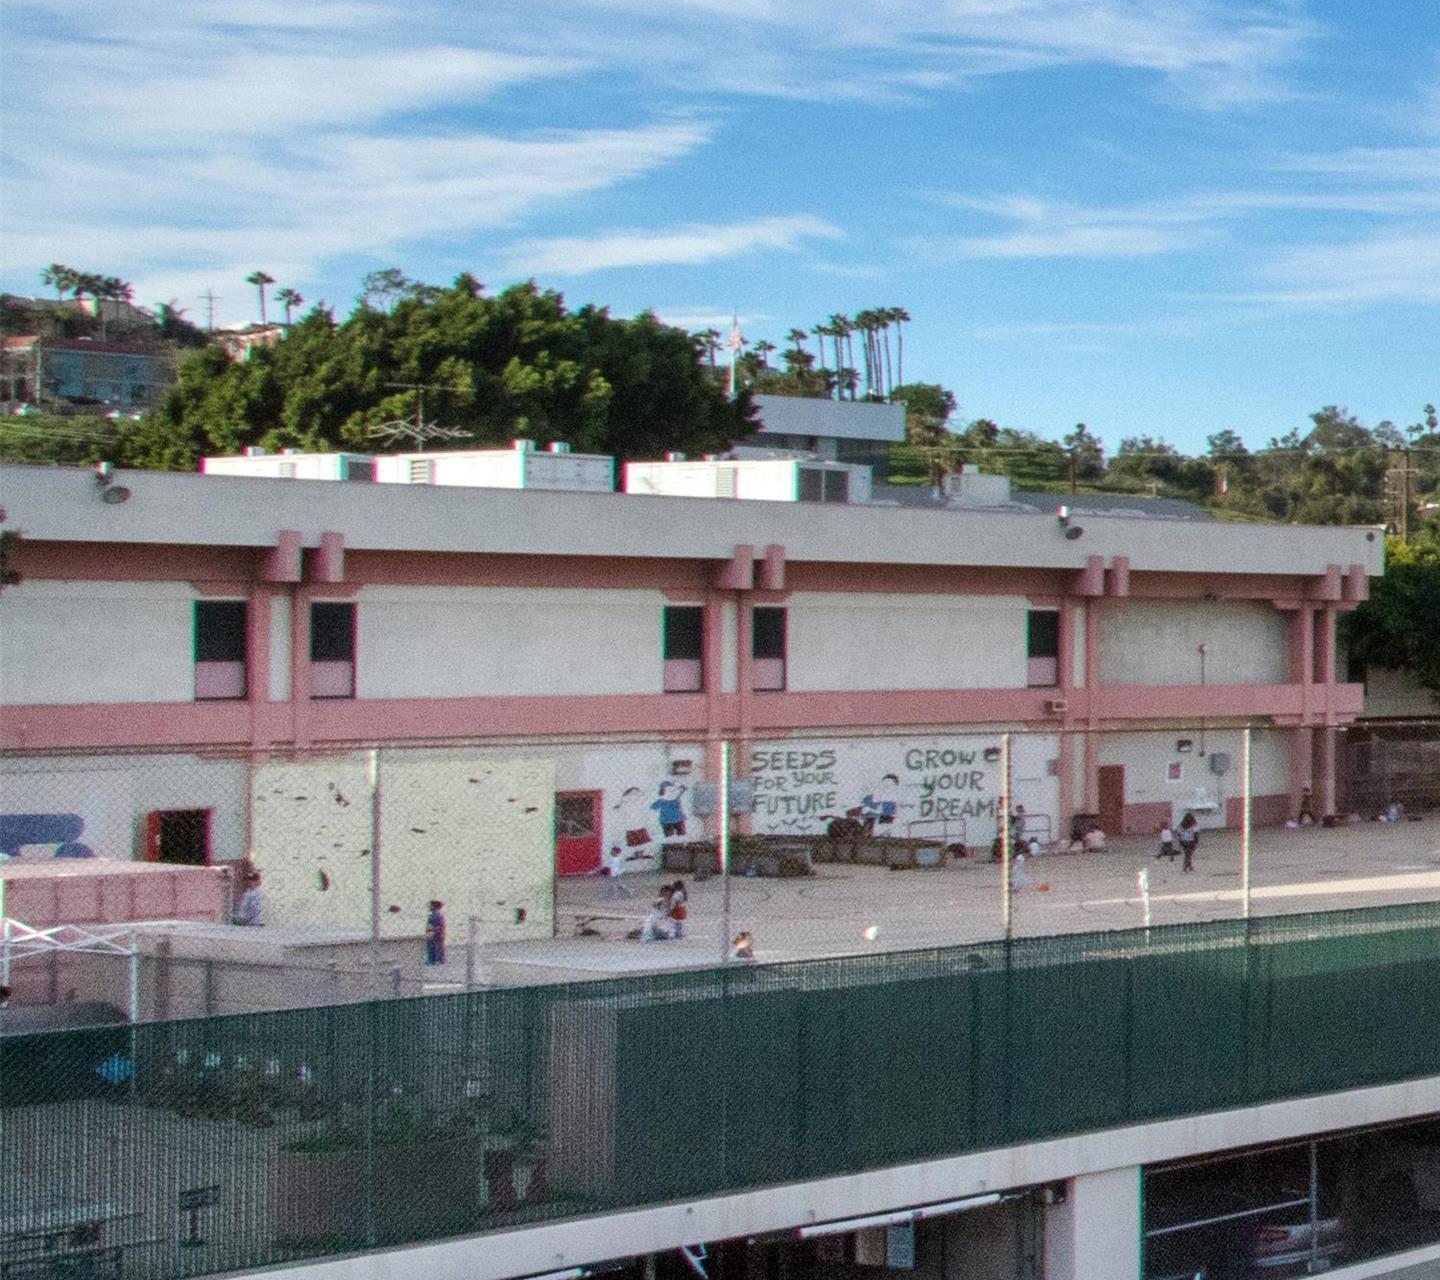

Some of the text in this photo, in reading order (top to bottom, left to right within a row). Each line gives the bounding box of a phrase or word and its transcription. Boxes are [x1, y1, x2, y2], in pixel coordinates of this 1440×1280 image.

[752, 749, 837, 771] SEEDS
[905, 748, 976, 771] GROW
[752, 771, 838, 792] FOR YOUR
[752, 791, 837, 817] FUTURE
